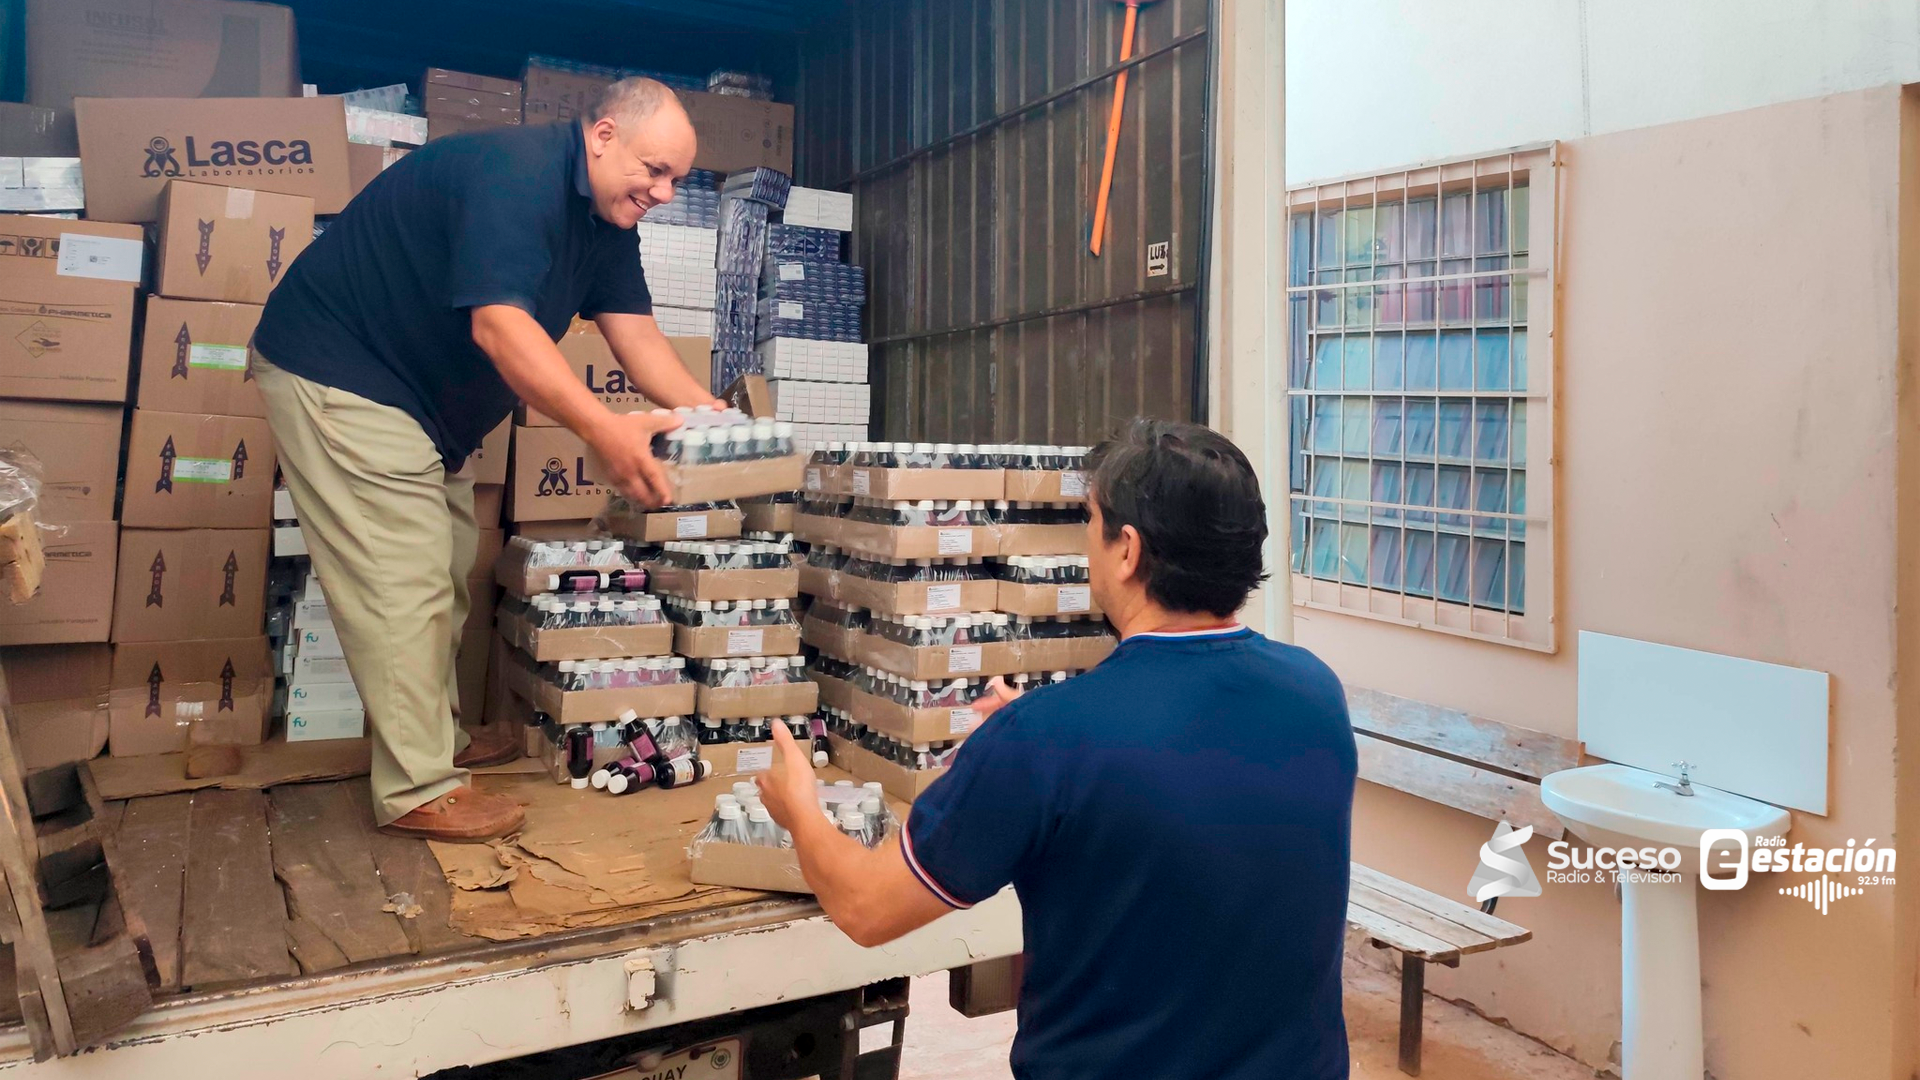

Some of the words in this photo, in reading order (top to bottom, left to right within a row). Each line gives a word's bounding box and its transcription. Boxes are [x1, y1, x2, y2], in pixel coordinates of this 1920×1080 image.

[185, 136, 313, 167] Lasca
[189, 167, 315, 177] Laboratorios
[162, 443, 171, 485] FRAGIL
[305, 632, 319, 643] fu
[293, 687, 308, 699] fu
[293, 716, 307, 728] fu
